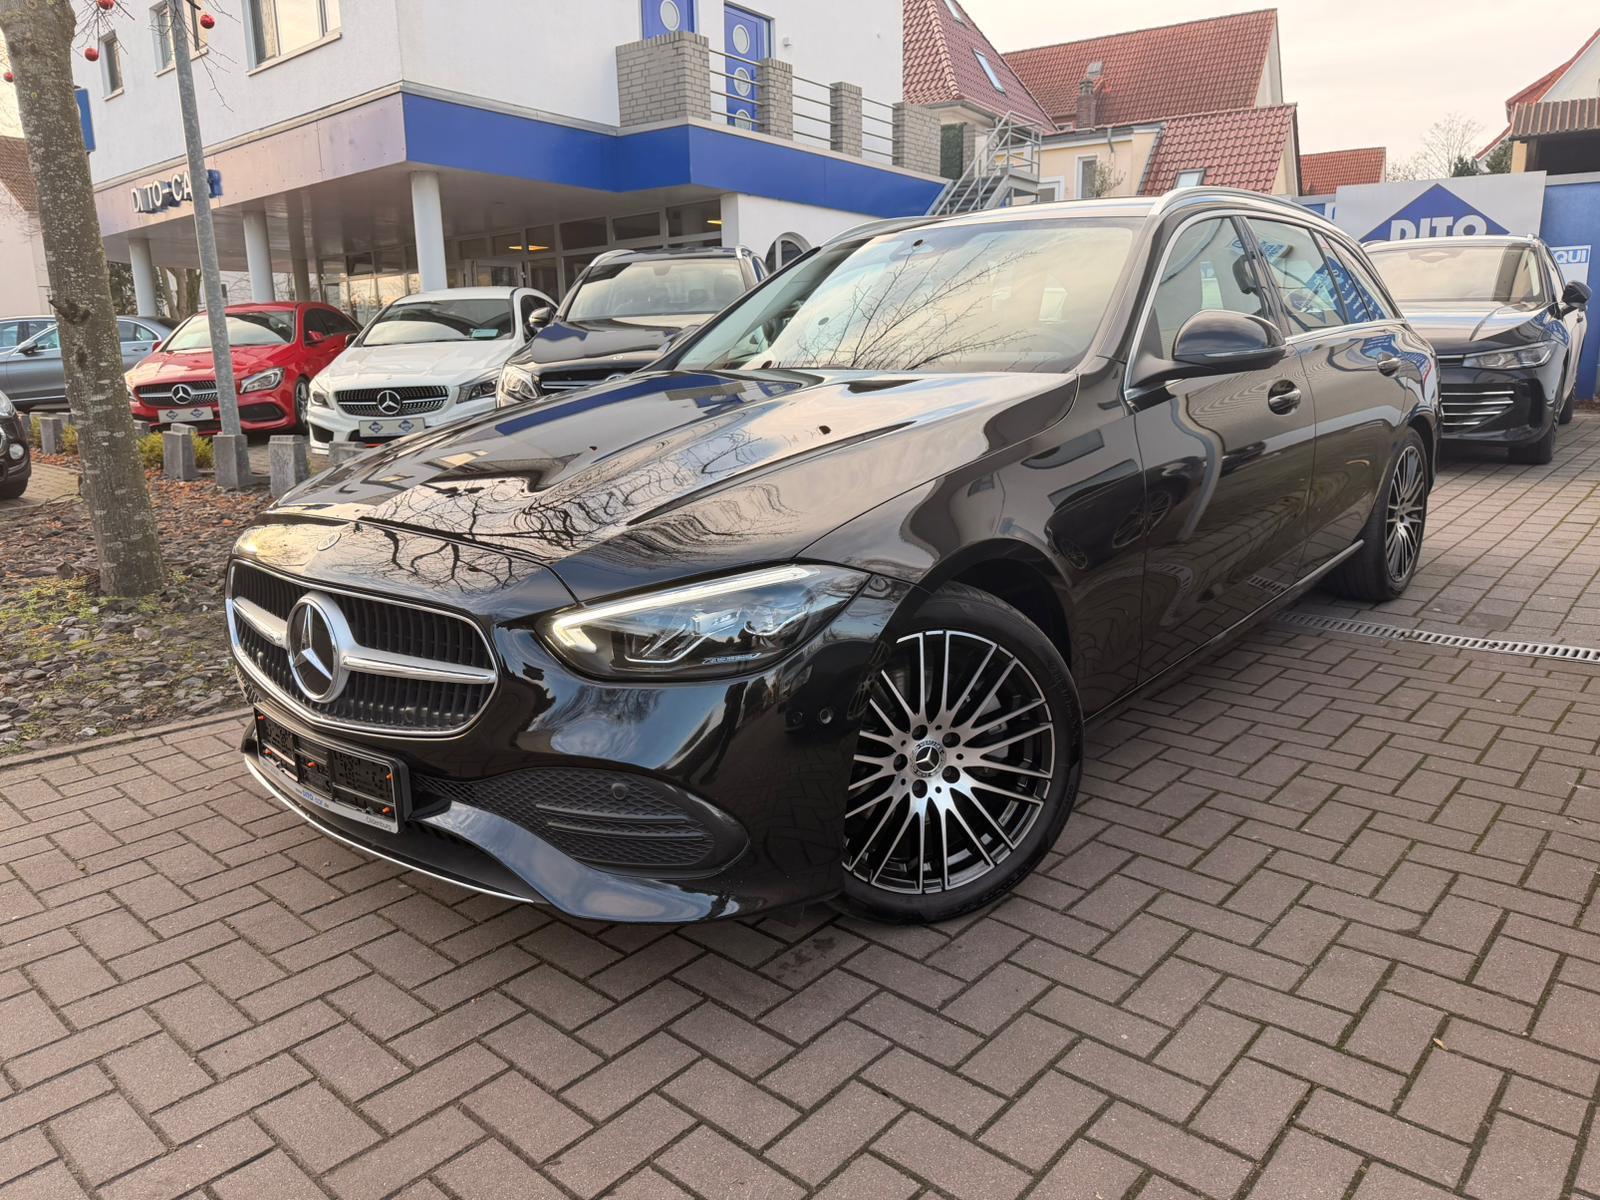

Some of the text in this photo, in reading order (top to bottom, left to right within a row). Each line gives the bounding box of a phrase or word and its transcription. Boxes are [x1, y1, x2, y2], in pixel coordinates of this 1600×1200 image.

[131, 171, 205, 212] DITO-CA
[1390, 215, 1487, 241] DITO
[1553, 249, 1587, 264] QUI
